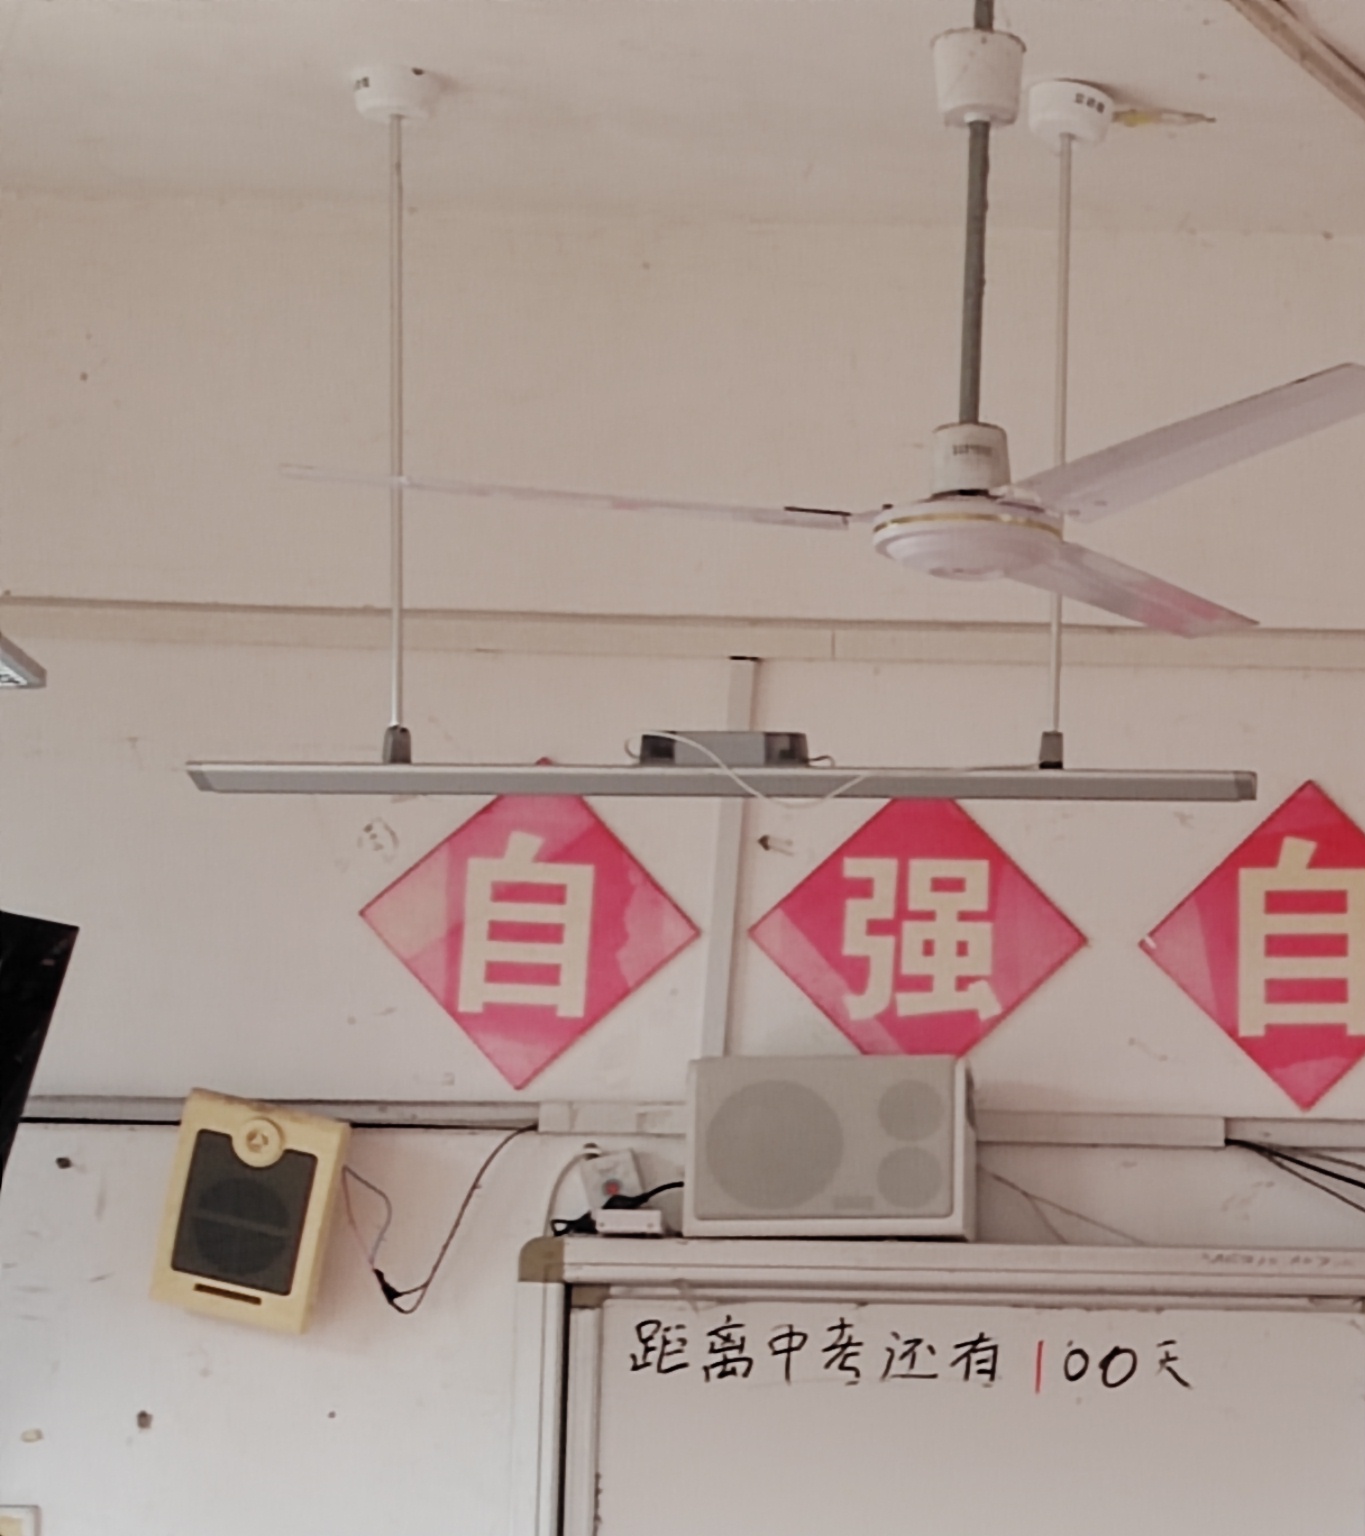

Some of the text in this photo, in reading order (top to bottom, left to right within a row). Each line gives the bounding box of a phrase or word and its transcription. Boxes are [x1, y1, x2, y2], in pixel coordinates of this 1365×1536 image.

[630, 1315, 1192, 1394] 距离中考还有100天
